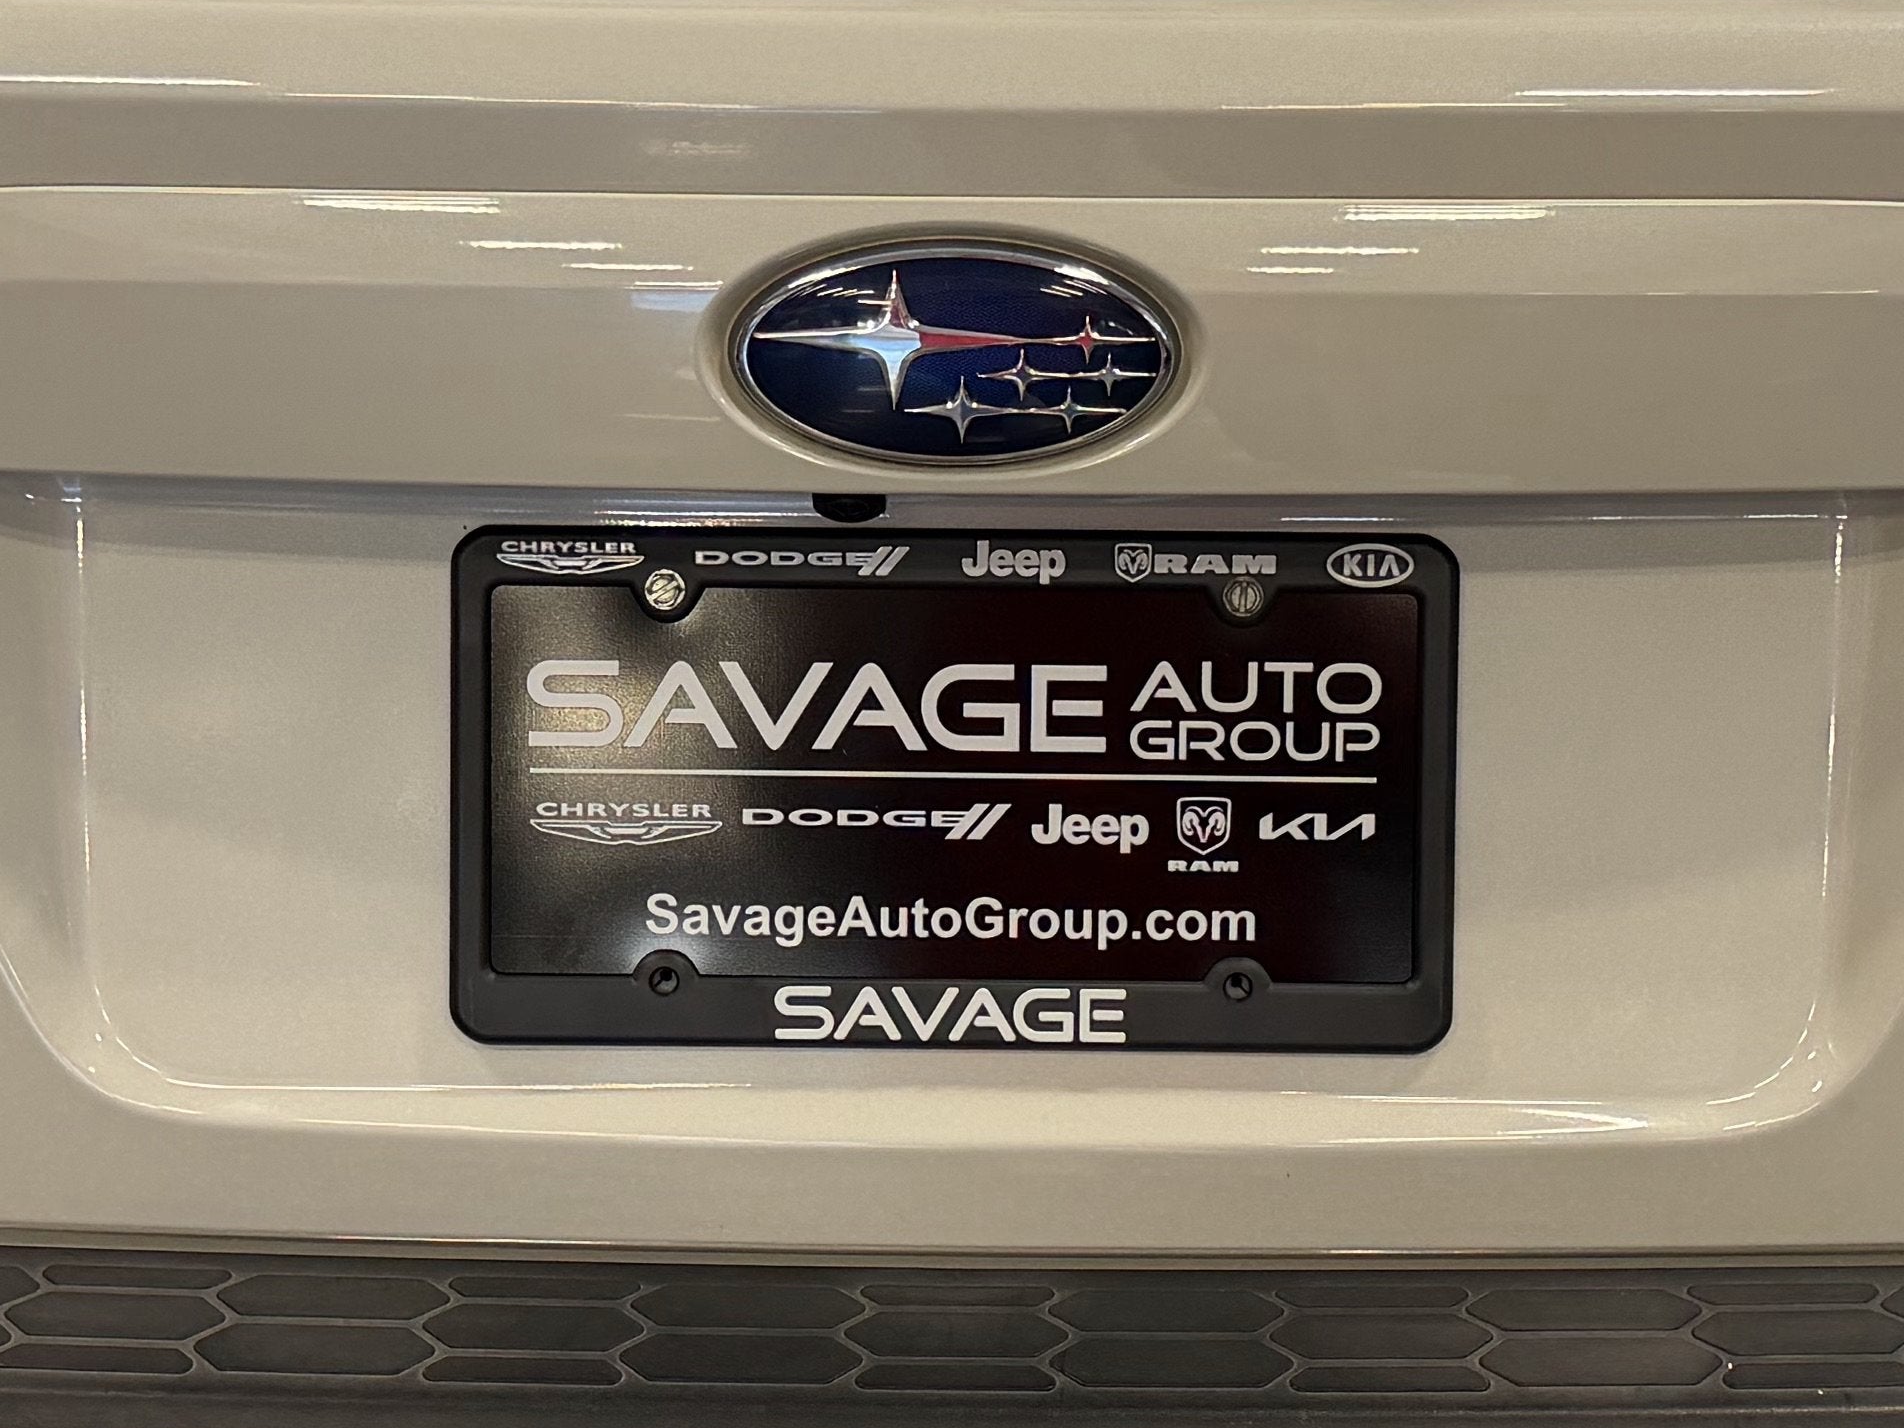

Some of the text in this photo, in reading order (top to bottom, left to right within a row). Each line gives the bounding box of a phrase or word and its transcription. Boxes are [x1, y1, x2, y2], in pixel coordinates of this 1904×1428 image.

[501, 540, 637, 555] CHRYSLER
[695, 549, 878, 569] DODGE
[961, 539, 1066, 585] Jeep
[1153, 553, 1277, 575] RAM
[526, 659, 1107, 754] SAVAGE
[1129, 660, 1383, 715] AUTO
[1129, 719, 1381, 763] GROUP
[536, 801, 713, 819] CHRYSLER
[742, 806, 976, 829] DODGE
[1031, 803, 1150, 854] Jeep
[1167, 859, 1240, 873] RAM
[645, 892, 1256, 951] SavageAutoGroup.com
[773, 985, 1127, 1043] SAVAGE
